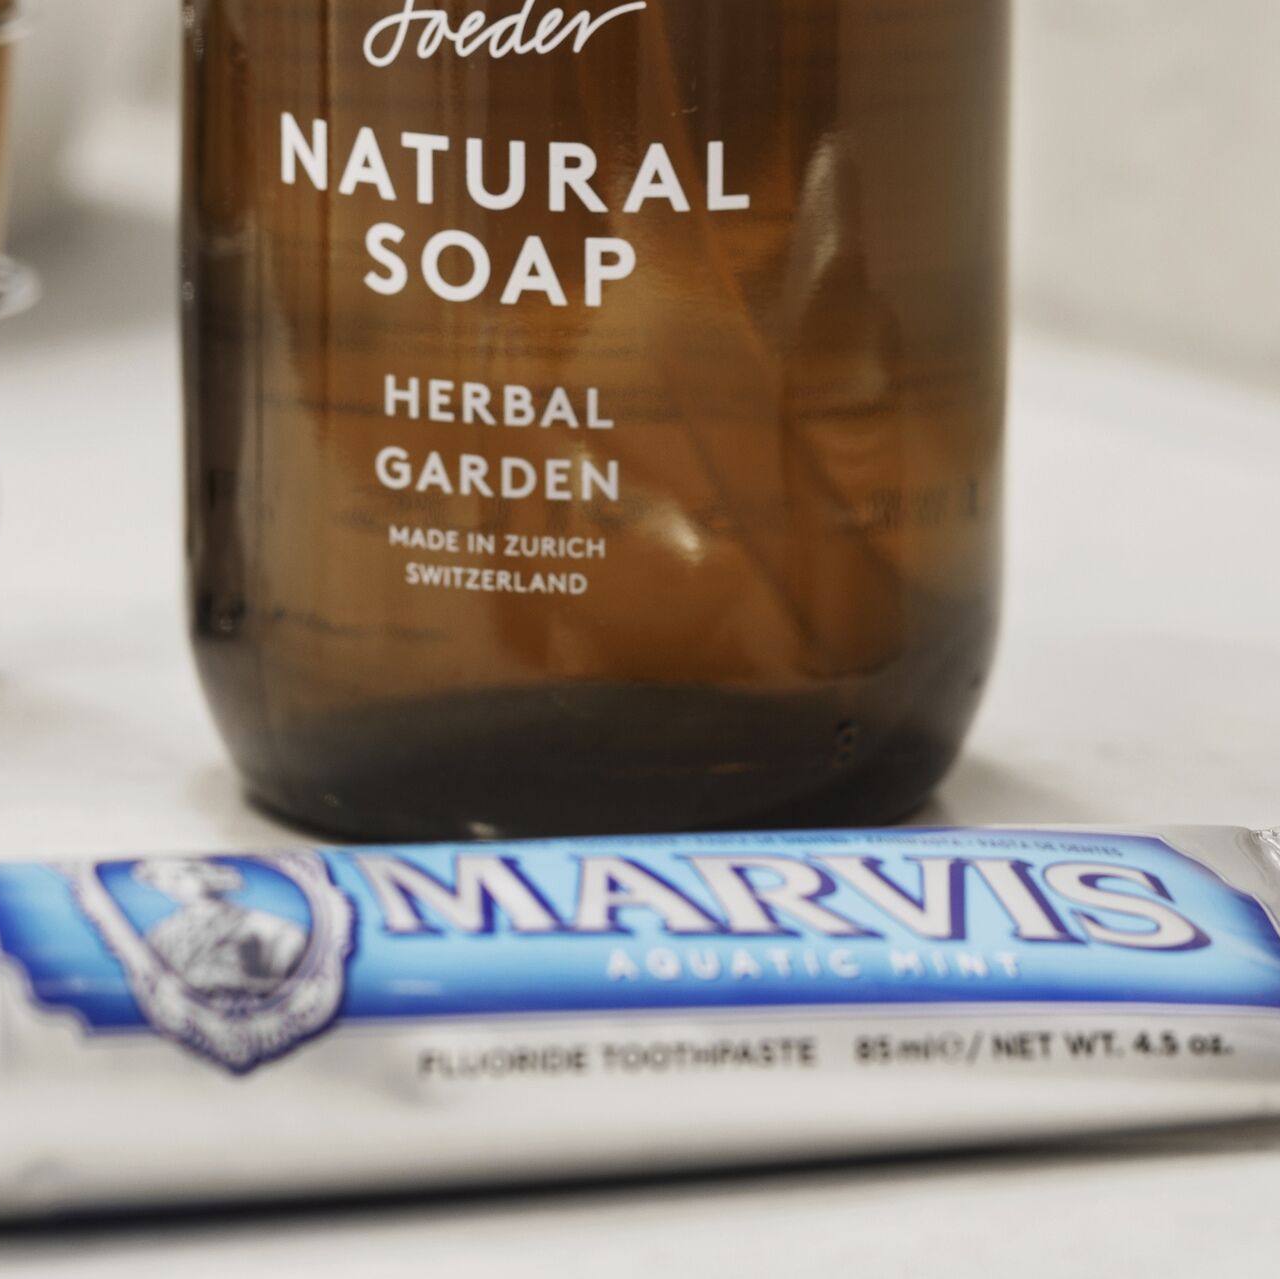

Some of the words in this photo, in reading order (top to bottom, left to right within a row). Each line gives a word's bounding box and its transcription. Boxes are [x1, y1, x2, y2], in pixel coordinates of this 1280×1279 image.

[280, 111, 751, 213] NATURAL
[363, 222, 637, 308] SOAP
[384, 373, 615, 429] HERBAL
[375, 446, 619, 501] GARDEN
[388, 524, 459, 553] MADE
[466, 533, 496, 555] IN
[503, 534, 606, 559] ZURICH
[405, 562, 588, 596] SWITZERLAND
[353, 853, 1212, 952] MARVIS
[606, 949, 861, 981] AQUATIC
[890, 949, 1020, 980] MINT
[421, 1045, 588, 1079] FLUORIDE
[602, 1036, 818, 1073] TOOTHPASTE
[991, 1029, 1054, 1060] NET
[1063, 1029, 1125, 1058] WT.
[1131, 1029, 1179, 1058] 4.5
[1187, 1032, 1235, 1058] oz.
